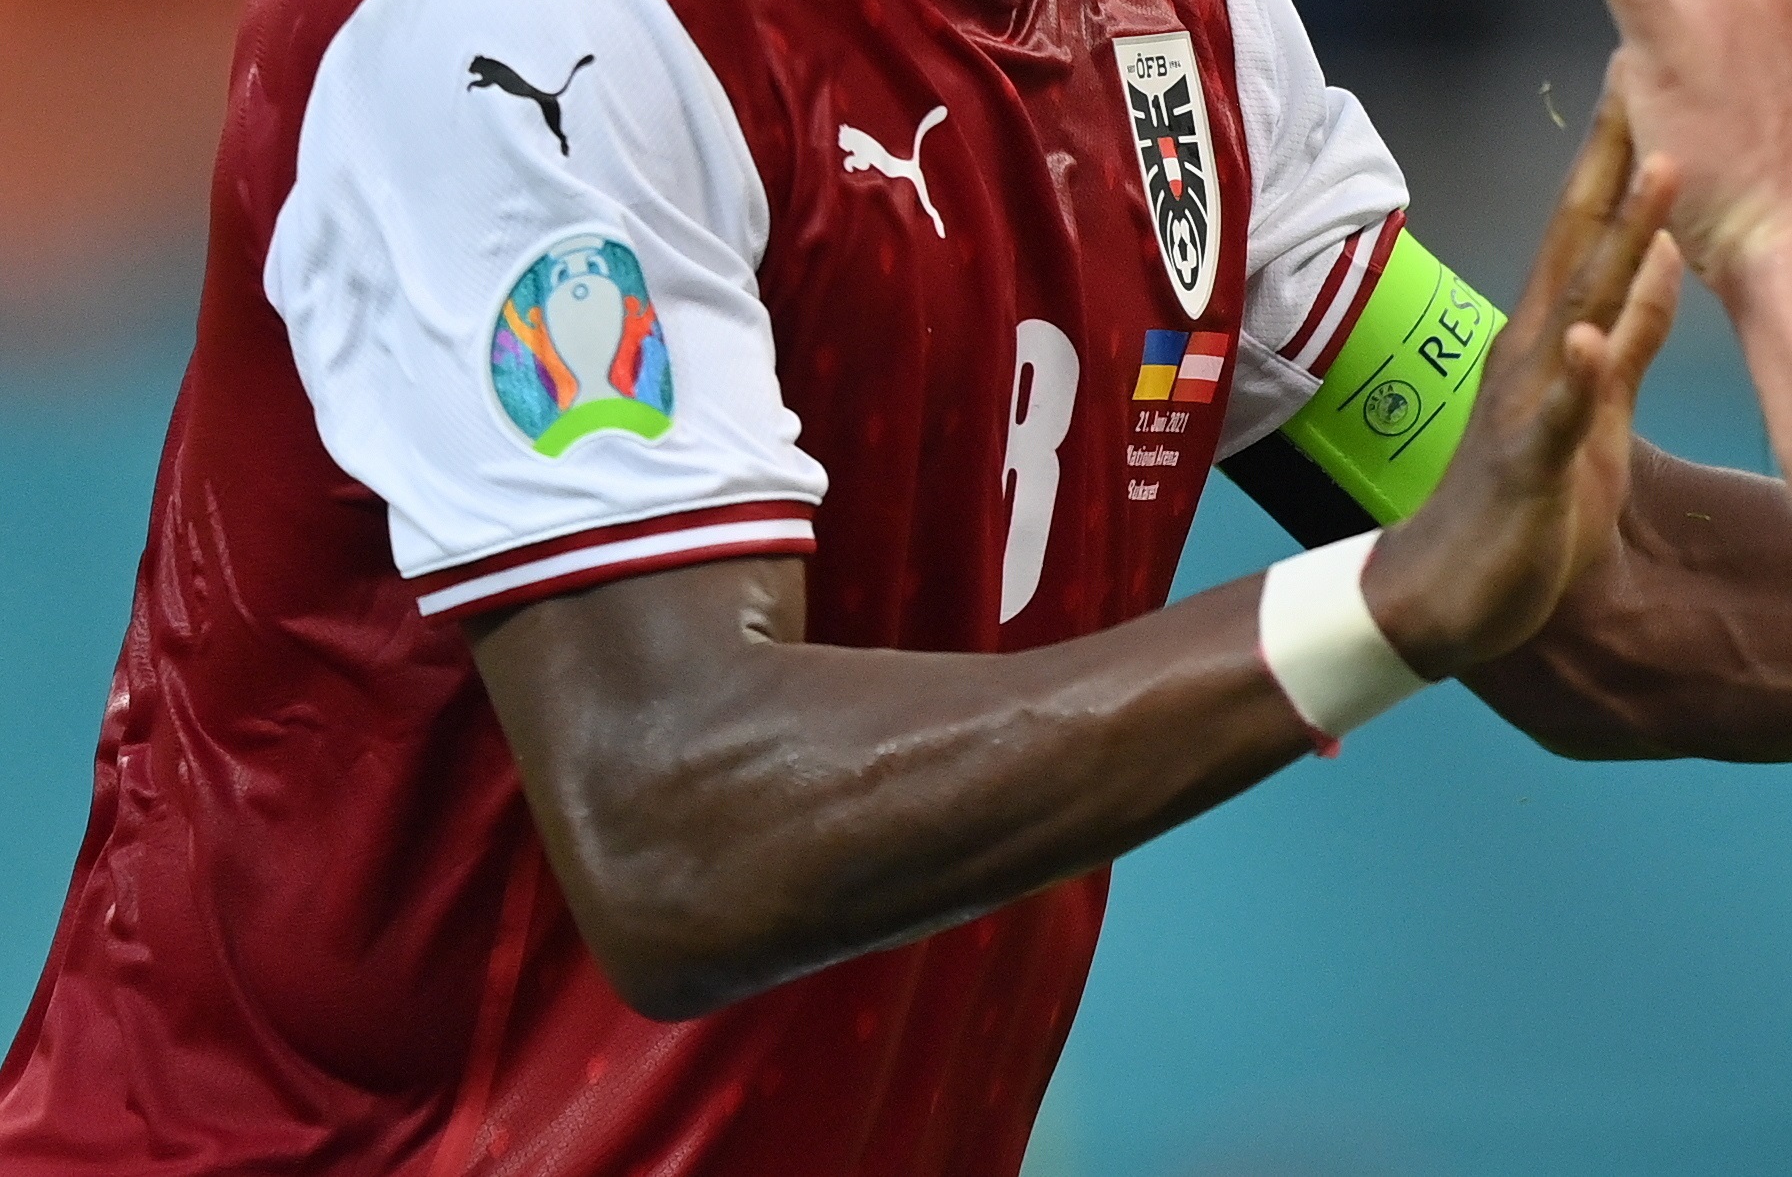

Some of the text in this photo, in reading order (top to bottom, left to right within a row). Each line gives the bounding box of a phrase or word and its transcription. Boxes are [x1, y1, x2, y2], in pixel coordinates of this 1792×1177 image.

[1136, 53, 1168, 79] ÖFB
[1135, 411, 1150, 433] 21.
[1165, 411, 1190, 434] 2021
